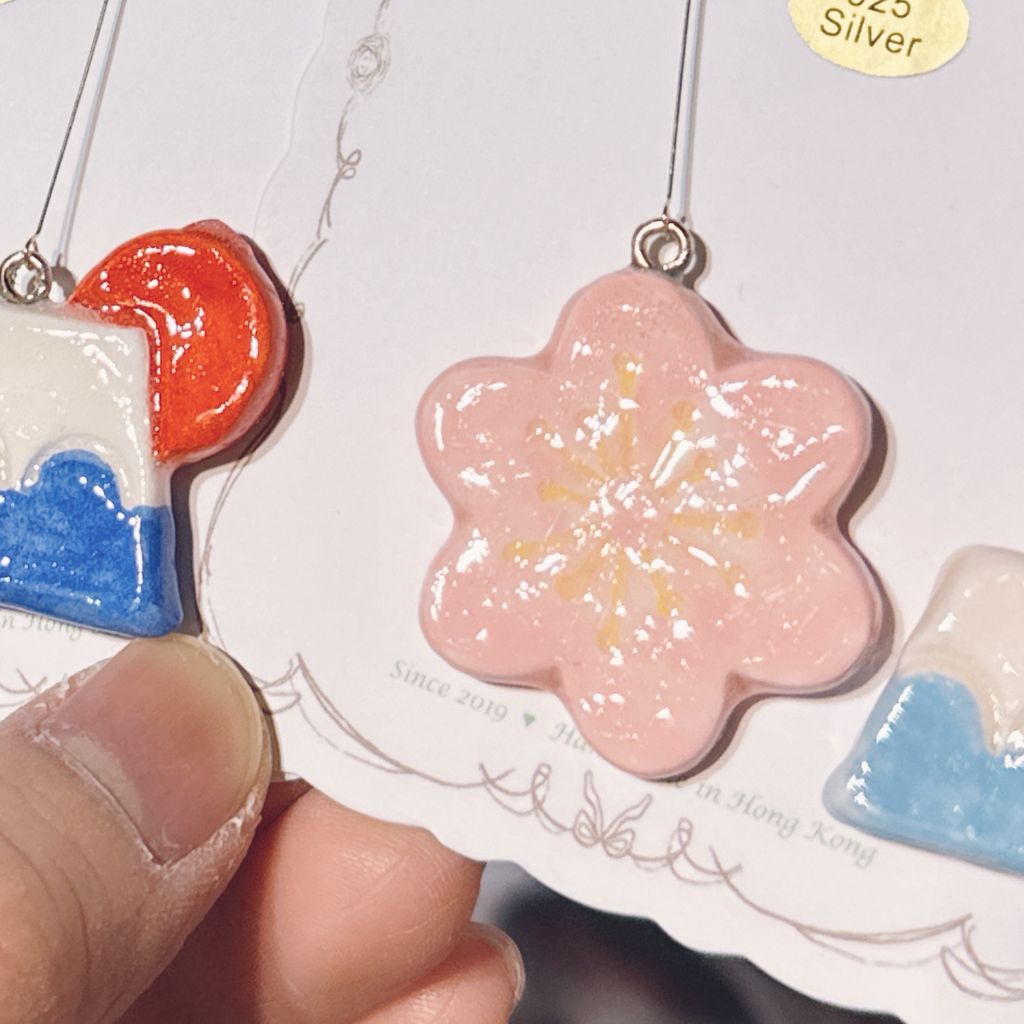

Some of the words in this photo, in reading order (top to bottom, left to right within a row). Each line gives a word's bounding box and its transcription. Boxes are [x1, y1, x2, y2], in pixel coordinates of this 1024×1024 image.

[819, 7, 923, 57] Silver
[389, 660, 451, 699] Since
[456, 690, 509, 724] 2019
[695, 780, 722, 805] in
[724, 792, 801, 839] Hong
[805, 820, 879, 867] Kong
